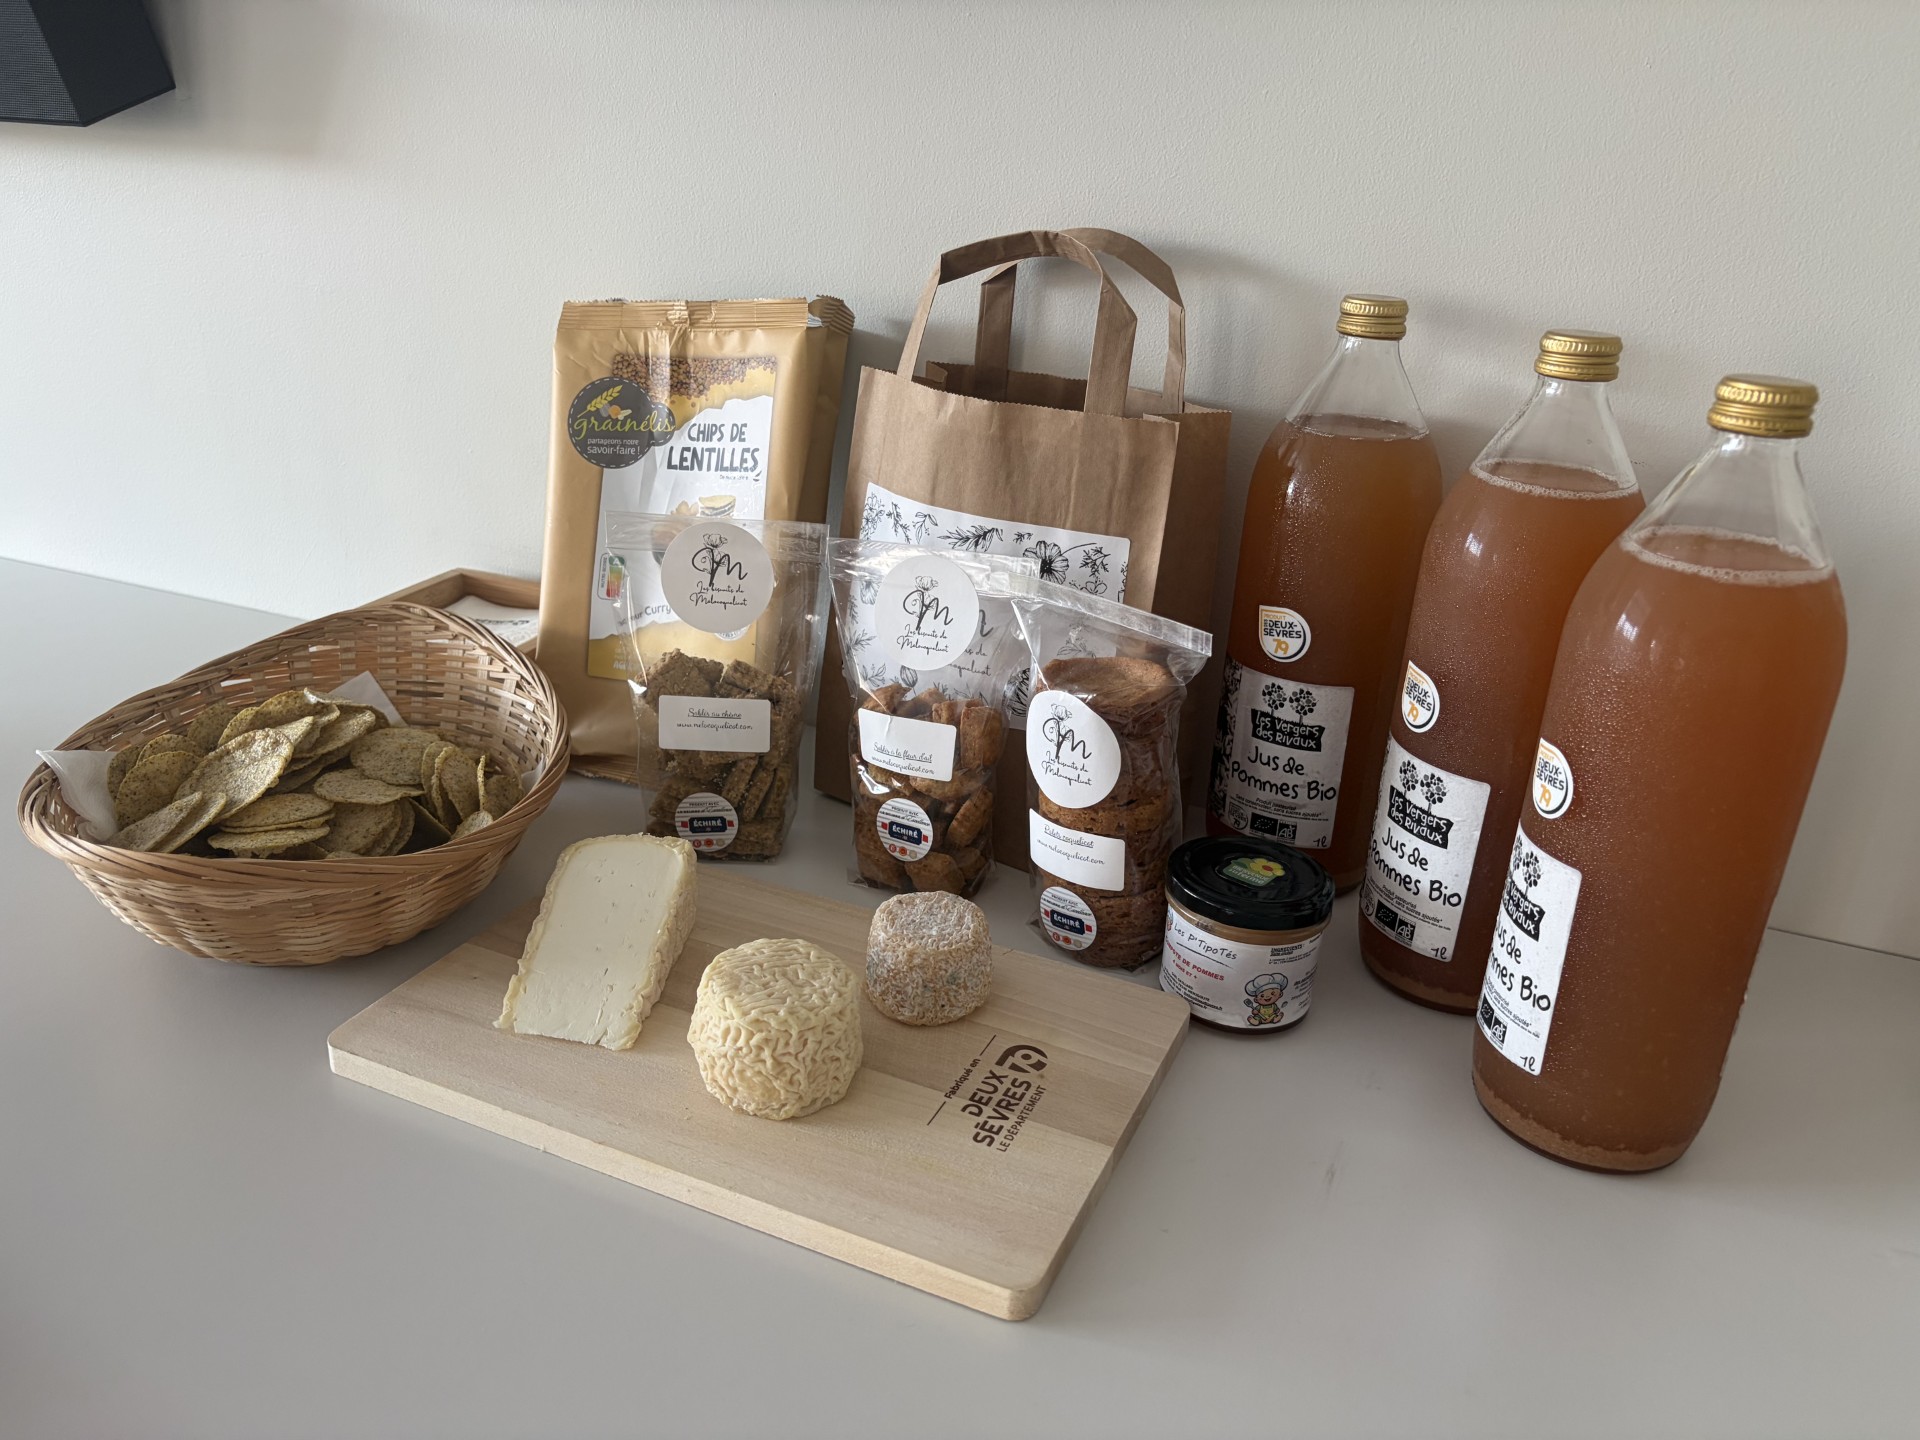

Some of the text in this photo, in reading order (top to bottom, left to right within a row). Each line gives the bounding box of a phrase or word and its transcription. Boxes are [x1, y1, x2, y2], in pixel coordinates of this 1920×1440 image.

[573, 411, 676, 440] grainélis
[687, 423, 748, 443] CHIPS DE
[587, 438, 622, 446] partageons
[587, 445, 636, 455] savoir-faire
[666, 446, 760, 473] LENTILLES
[644, 604, 672, 616] Curry
[1268, 619, 1298, 630] DEUX-
[1247, 746, 1305, 775] Jus de
[1231, 761, 1337, 801] Pommes Bio
[1381, 826, 1429, 872] Jus de
[1428, 879, 1462, 908] Bio
[1174, 922, 1185, 937] Les
[1505, 935, 1522, 964] de
[1192, 964, 1225, 982] POMMES
[1520, 974, 1552, 1012] Bio
[944, 1058, 982, 1100] Fabriqué en
[960, 1069, 1010, 1118] DEUX
[972, 1077, 1033, 1148] SÈVRES
[995, 1085, 1048, 1153] LE DÉPARTEMENT
